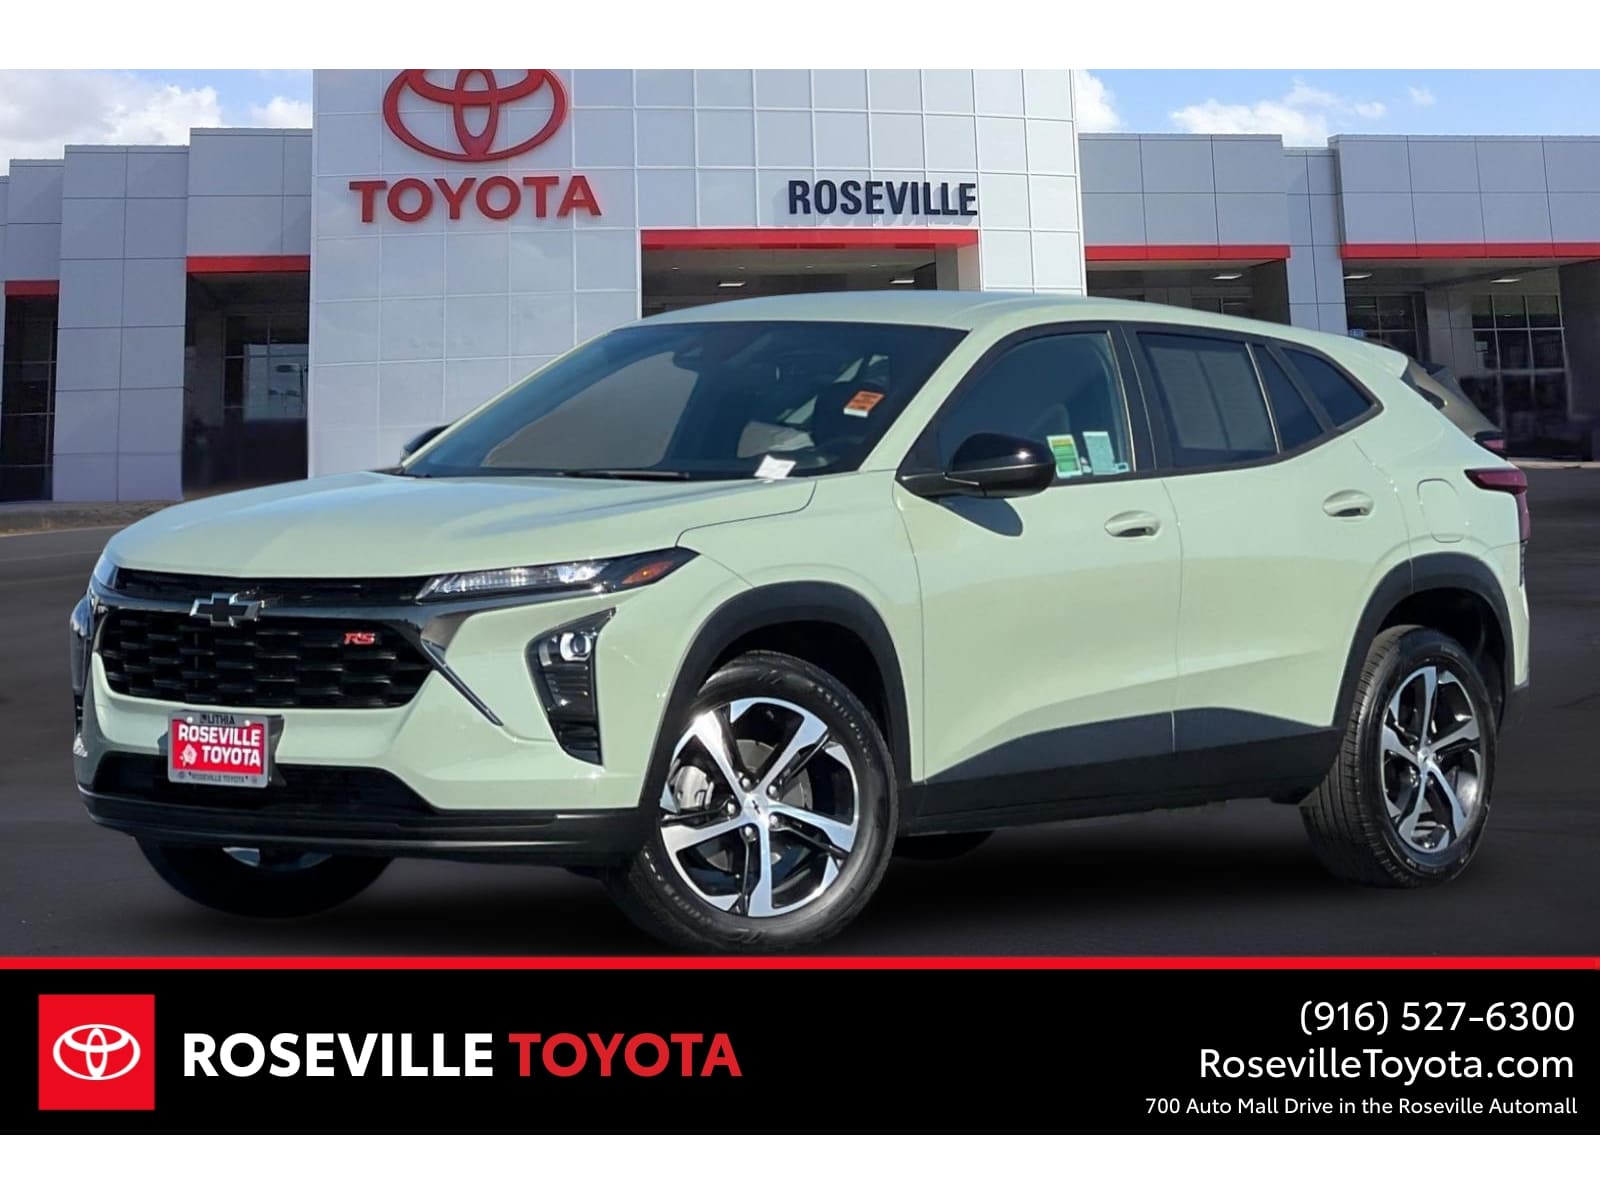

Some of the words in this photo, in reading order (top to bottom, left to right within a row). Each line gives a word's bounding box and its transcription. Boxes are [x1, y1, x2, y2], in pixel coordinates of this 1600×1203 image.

[349, 175, 601, 223] TOYOTA
[788, 180, 979, 217] ROSEVILLE
[344, 632, 376, 645] RS
[178, 725, 261, 747] ROSEVILLE
[202, 746, 261, 767] TOYOTA
